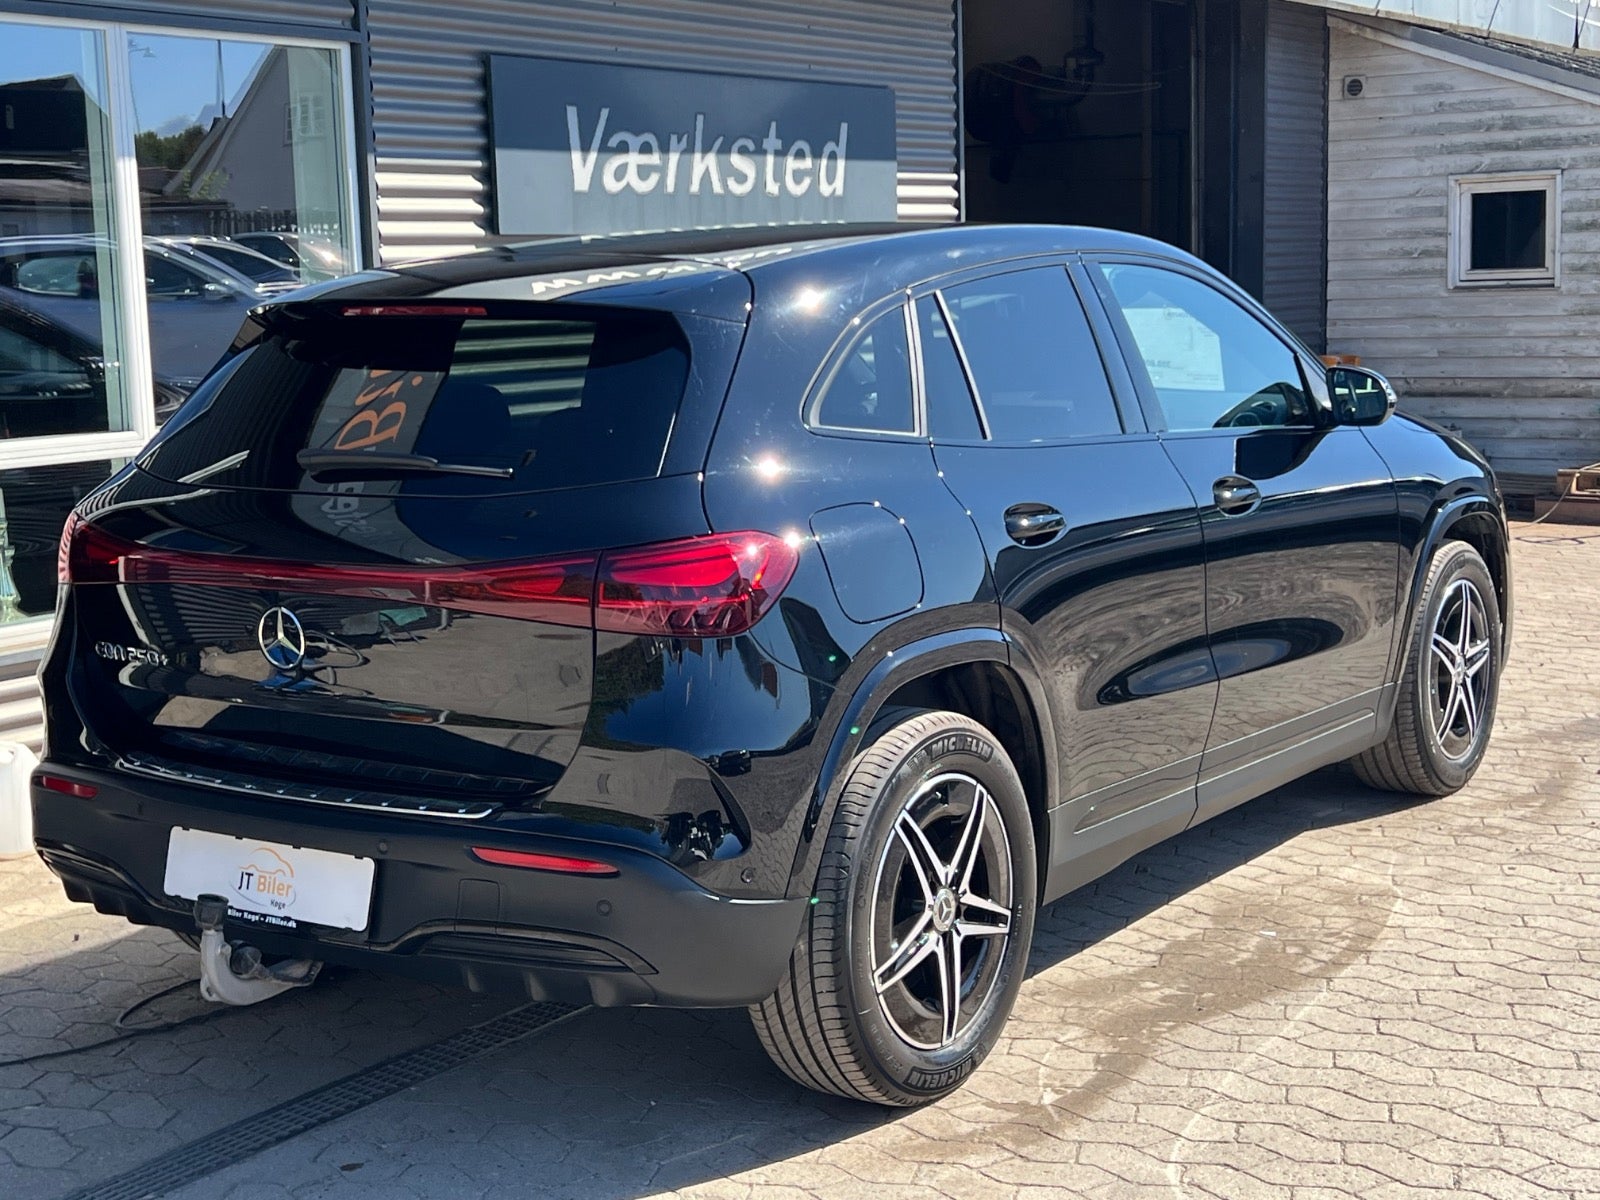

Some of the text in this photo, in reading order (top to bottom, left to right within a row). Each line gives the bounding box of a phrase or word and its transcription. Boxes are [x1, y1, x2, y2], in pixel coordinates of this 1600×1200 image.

[566, 104, 849, 198] Værksted
[931, 735, 993, 760] MICHELIN
[238, 871, 293, 897] JT Biler
[908, 1057, 973, 1087] MICHELIN
